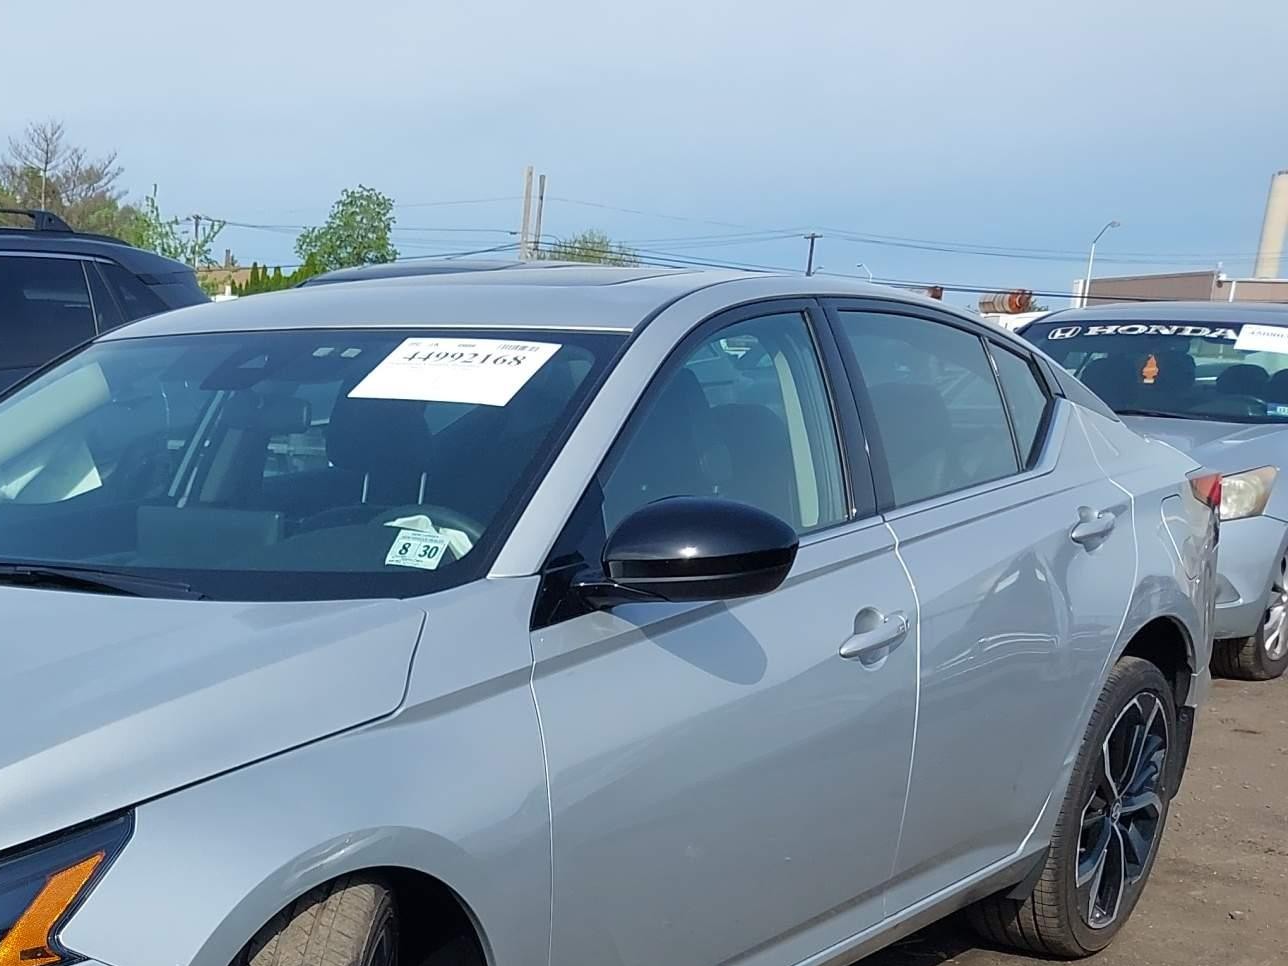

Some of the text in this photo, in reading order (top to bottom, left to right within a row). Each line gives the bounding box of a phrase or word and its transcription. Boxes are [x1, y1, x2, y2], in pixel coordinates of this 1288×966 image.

[1083, 324, 1239, 340] HONDA
[402, 351, 527, 366] 44992168
[398, 542, 439, 559] 8 30
